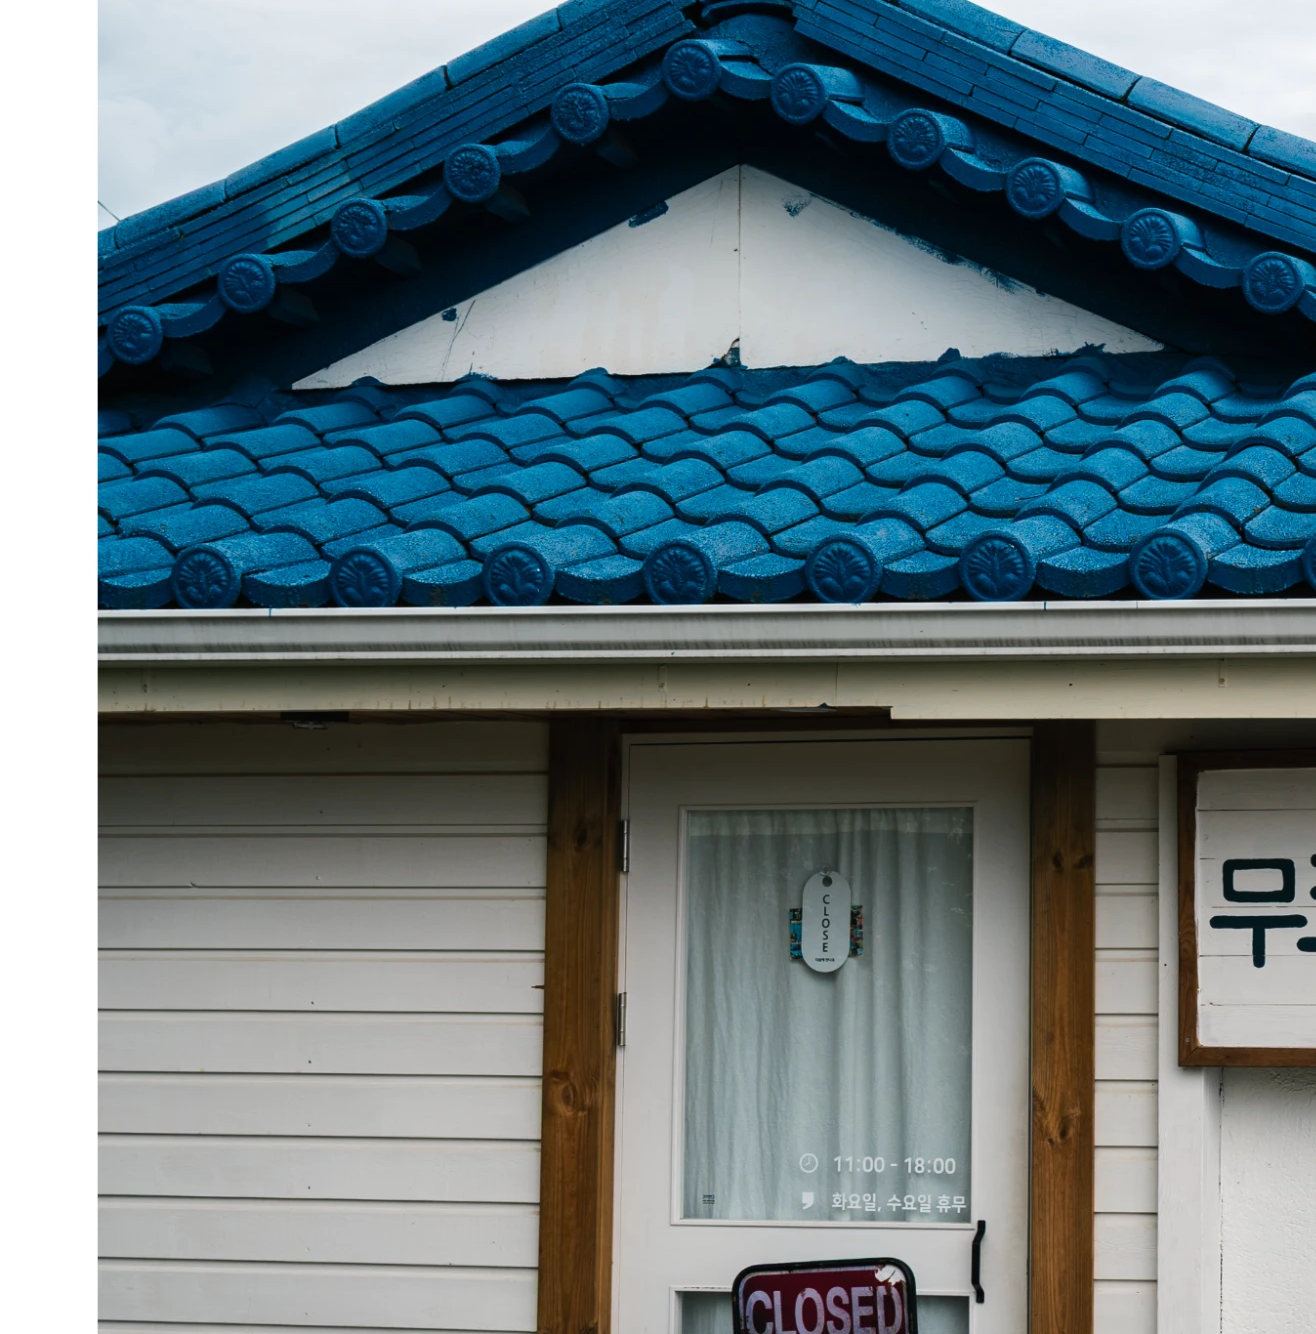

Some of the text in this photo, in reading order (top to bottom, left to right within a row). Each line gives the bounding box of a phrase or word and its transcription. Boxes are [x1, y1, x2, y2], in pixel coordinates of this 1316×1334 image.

[821, 894, 831, 953] CLOSE
[833, 1156, 885, 1173] 11:00
[903, 1157, 956, 1175] 18:00
[831, 1192, 967, 1214] 화요일, 수요일 휴무
